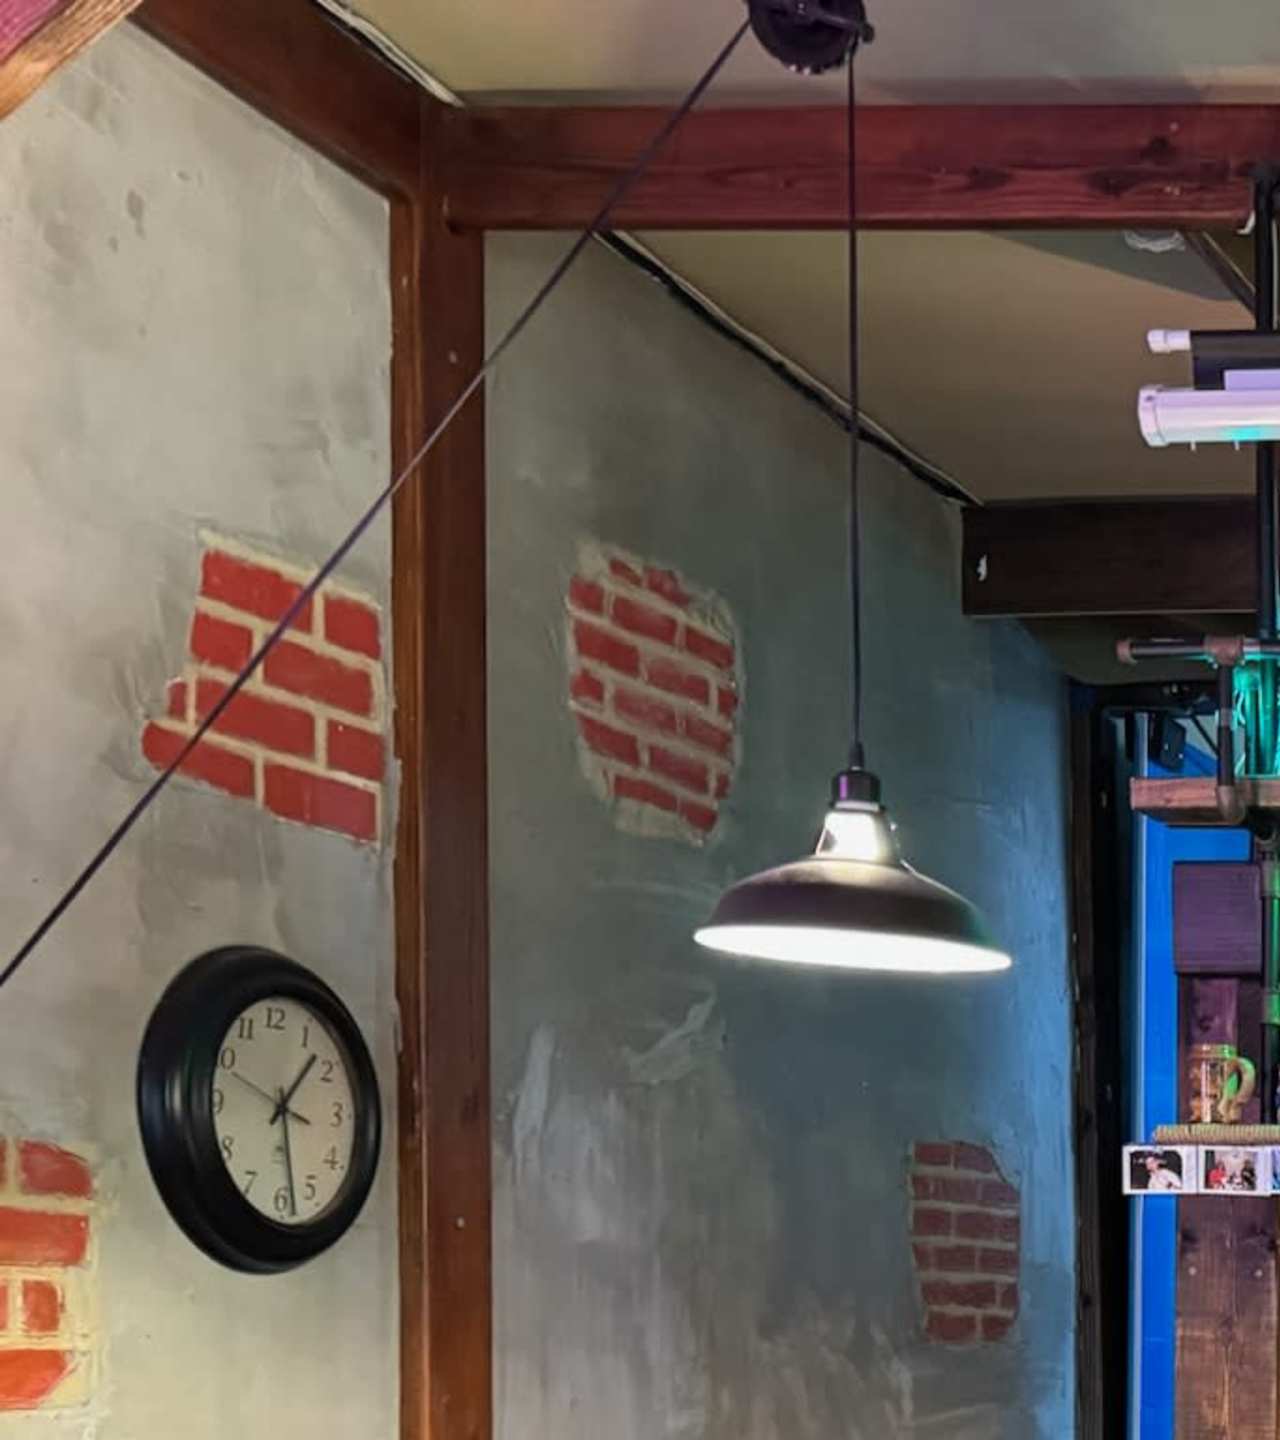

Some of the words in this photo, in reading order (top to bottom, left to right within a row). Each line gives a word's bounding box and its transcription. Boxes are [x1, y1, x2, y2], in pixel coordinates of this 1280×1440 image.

[238, 1017, 254, 1040] 11
[264, 1007, 286, 1030] 12
[301, 1025, 309, 1048] 1
[220, 1048, 236, 1071] 0
[320, 1060, 334, 1083] 2
[331, 1102, 343, 1127] 3
[222, 1136, 233, 1159] 8
[323, 1147, 340, 1170] 4
[243, 1171, 258, 1195] 7
[304, 1175, 316, 1200] 5
[274, 1186, 288, 1212] 6
